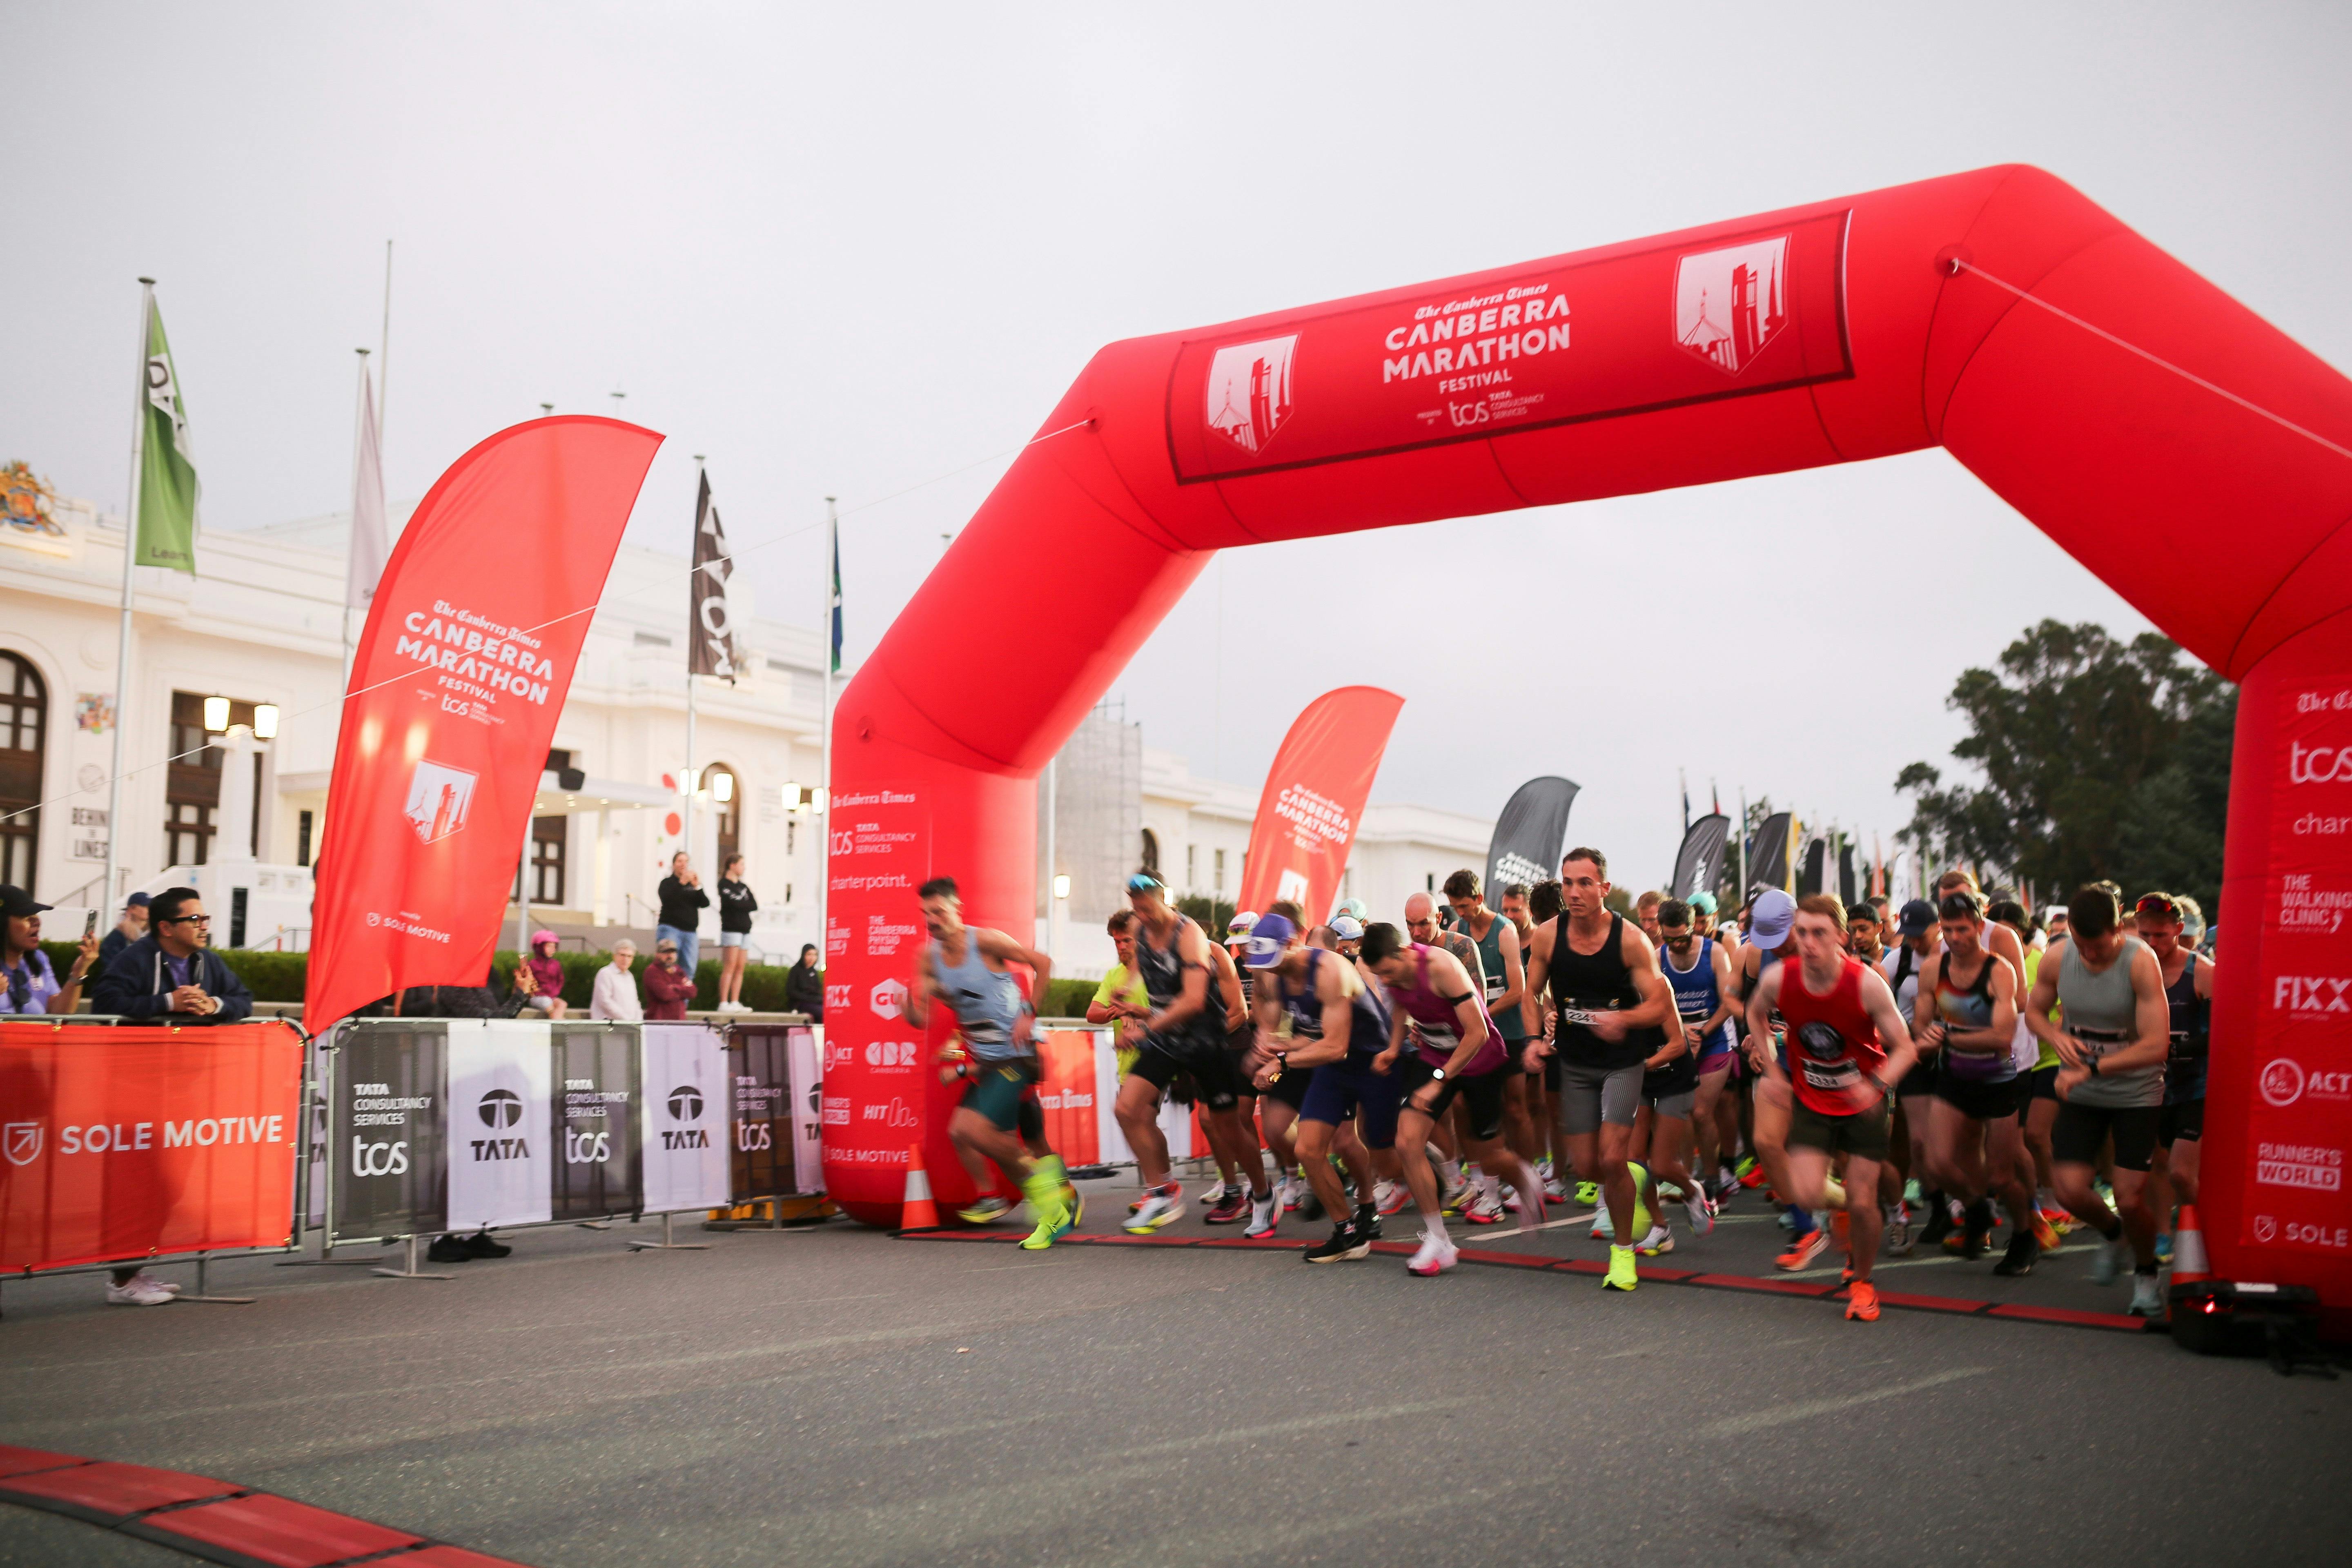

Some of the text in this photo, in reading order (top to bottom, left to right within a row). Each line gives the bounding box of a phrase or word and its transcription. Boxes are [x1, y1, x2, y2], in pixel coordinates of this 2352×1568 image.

[1414, 283, 1549, 321] The Canberra Times
[1385, 294, 1570, 351] CANBERRA
[1383, 323, 1570, 384] MARATHON
[1439, 368, 1512, 394] FESTIVAL
[1448, 400, 1490, 428] tcs
[433, 599, 542, 649] The Canberra Times
[405, 612, 552, 682] CANBERRA
[395, 635, 549, 705] MARATHON
[438, 675, 497, 704] FESTIVAL
[441, 693, 469, 716] tcs
[2290, 740, 2352, 784] tcs
[881, 790, 916, 804] Times
[1279, 788, 1350, 831] CANBERRA
[1274, 802, 1348, 845] MARATHON
[2282, 873, 2312, 891] THE
[2281, 891, 2352, 909] WALKING
[2279, 908, 2330, 926] CLINIC
[406, 924, 450, 943] MOTIVE
[2273, 976, 2352, 1013] FIXX
[353, 1083, 390, 1095] TATA
[565, 1078, 594, 1091] TATA
[2307, 1071, 2352, 1092] ACT
[353, 1097, 432, 1111] CONSULTANCY
[565, 1091, 630, 1104] CONSULTANCY
[353, 1113, 405, 1126] SERVICES
[565, 1106, 608, 1118] SERVICES
[863, 1105, 889, 1120] HIT
[61, 1115, 283, 1154] SOLE MOTIVE
[565, 1125, 610, 1164] tcs
[662, 1129, 709, 1150] TATA
[736, 1118, 771, 1152] tcs
[352, 1135, 409, 1177] tcs
[471, 1138, 530, 1162] TATA
[855, 1149, 909, 1163] MOTIVE
[2257, 1142, 2343, 1166] RUNNER'S
[2261, 1163, 2337, 1187] WORLD
[2285, 1222, 2349, 1248] SOLE
